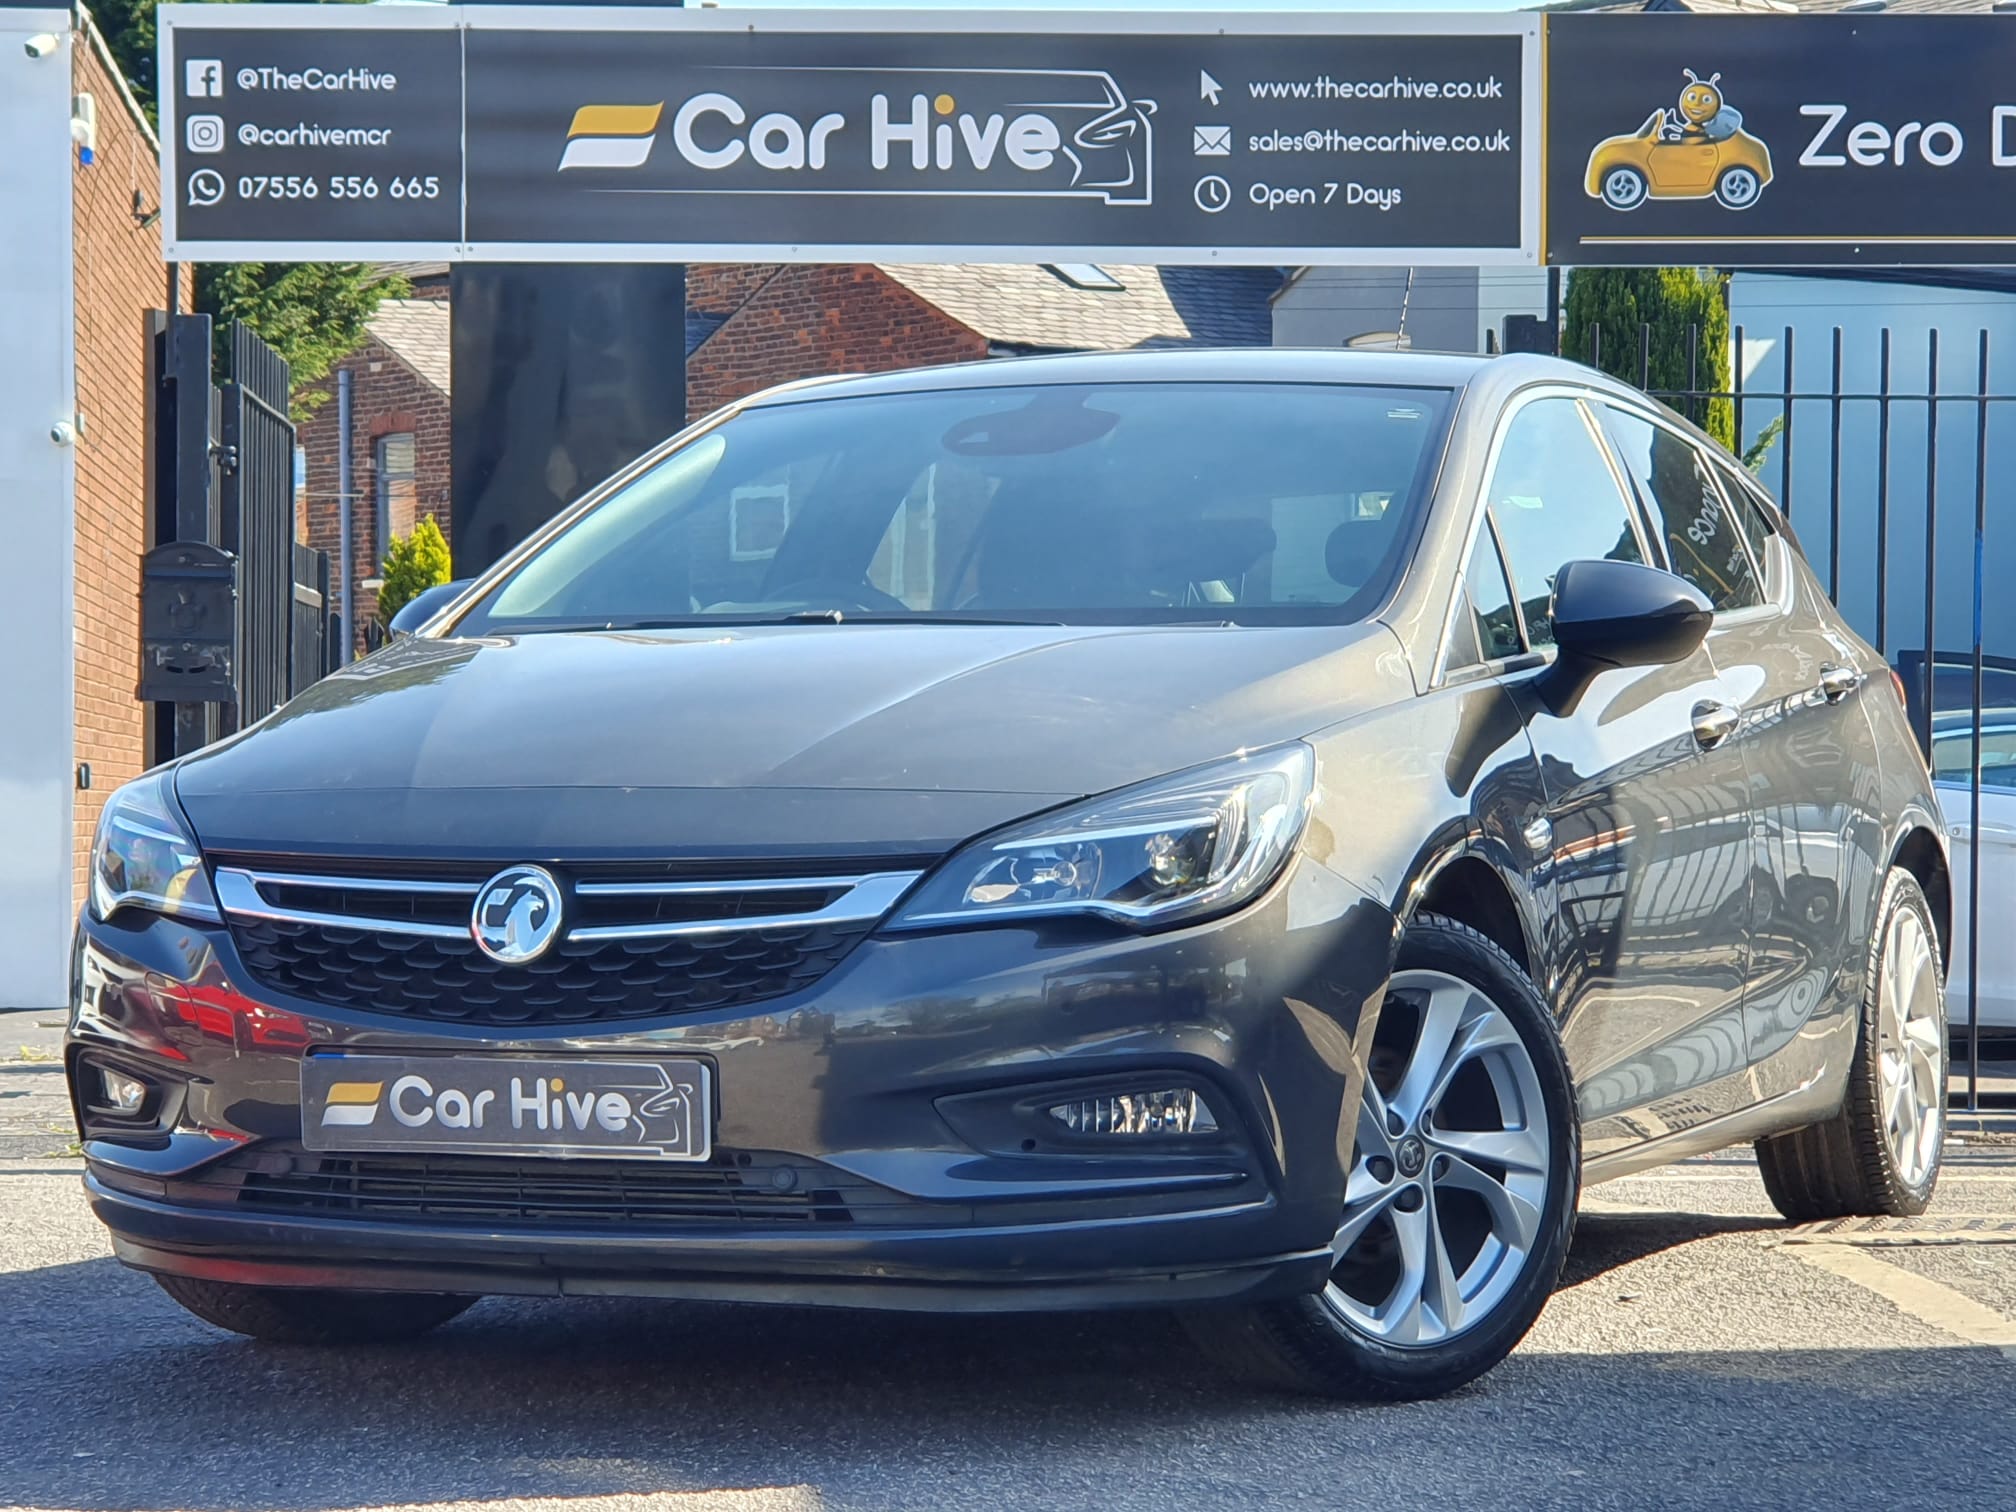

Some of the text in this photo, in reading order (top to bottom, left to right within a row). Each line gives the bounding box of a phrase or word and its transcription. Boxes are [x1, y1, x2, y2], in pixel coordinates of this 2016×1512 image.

[237, 66, 398, 90] @TheCarHive
[1248, 75, 1503, 99] www.thecarhive.co.uk
[238, 122, 392, 146] @carhivemcr
[673, 92, 1062, 171] Car Hive
[1249, 129, 1511, 153] sales@thecarhive.co.uk
[1798, 104, 1964, 167] Zero
[238, 176, 440, 199] 07556 556 665
[1249, 182, 1403, 212] Open 7 Days
[389, 1075, 631, 1131] Car Hive
